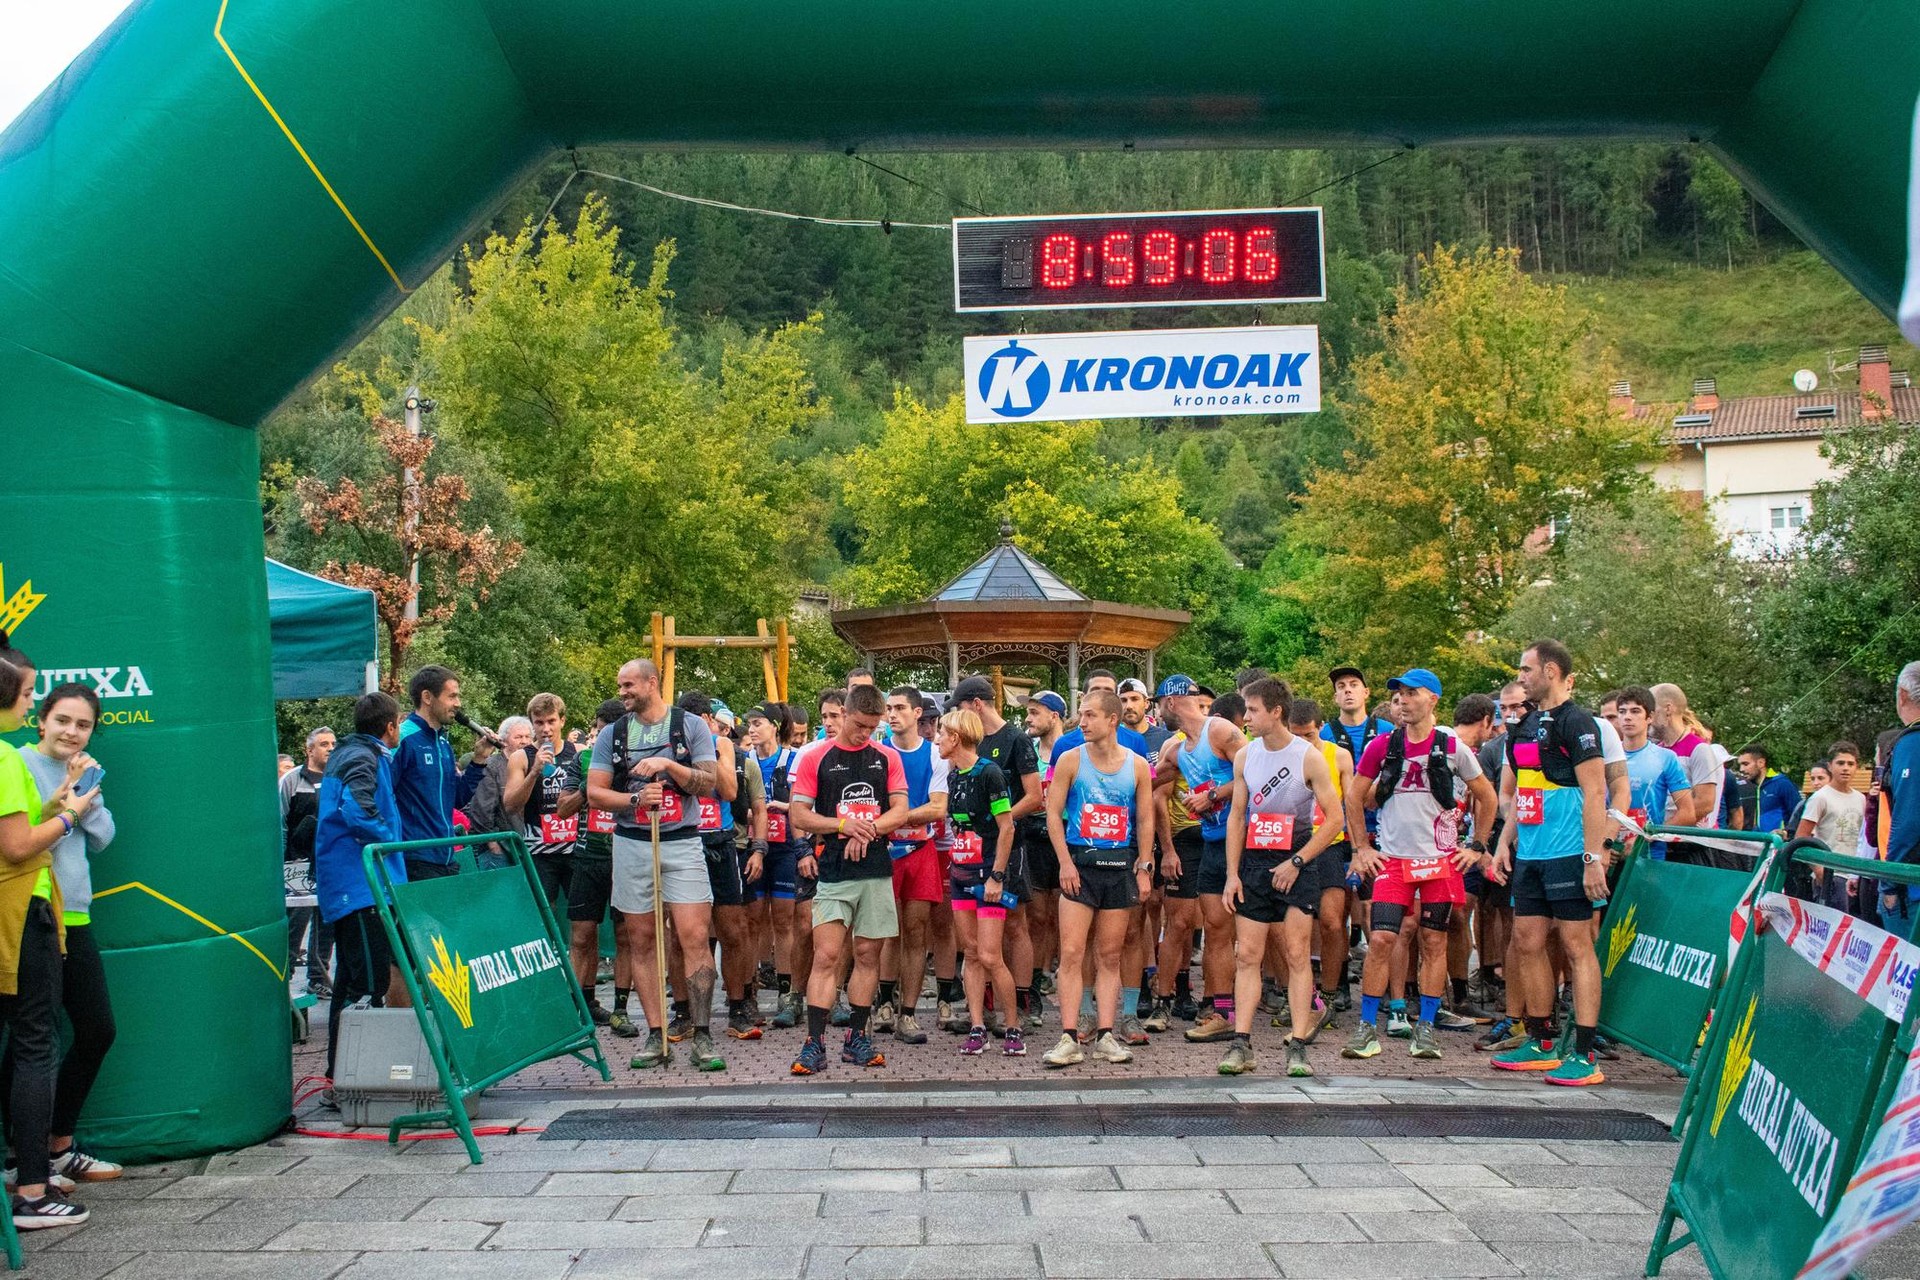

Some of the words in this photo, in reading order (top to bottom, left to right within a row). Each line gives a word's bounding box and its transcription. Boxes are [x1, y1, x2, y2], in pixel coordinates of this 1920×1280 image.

[1042, 229, 1278, 289] 8:59:06
[1059, 352, 1312, 393] KRONOAK
[1173, 393, 1301, 407] kronoak.com
[32, 666, 153, 700] UTXA
[98, 710, 154, 726] OCIAL
[700, 804, 714, 815] 72
[550, 819, 573, 830] 217
[1090, 811, 1119, 826] 336
[1255, 821, 1283, 834] 256
[953, 838, 971, 850] 351
[468, 949, 519, 993] RURAL
[510, 937, 559, 979] KUTXA
[1628, 932, 1670, 973] RURAL
[1664, 943, 1717, 989] KUTXA
[1738, 1058, 1790, 1156] RURAL
[1777, 1097, 1839, 1218] KUTXA
